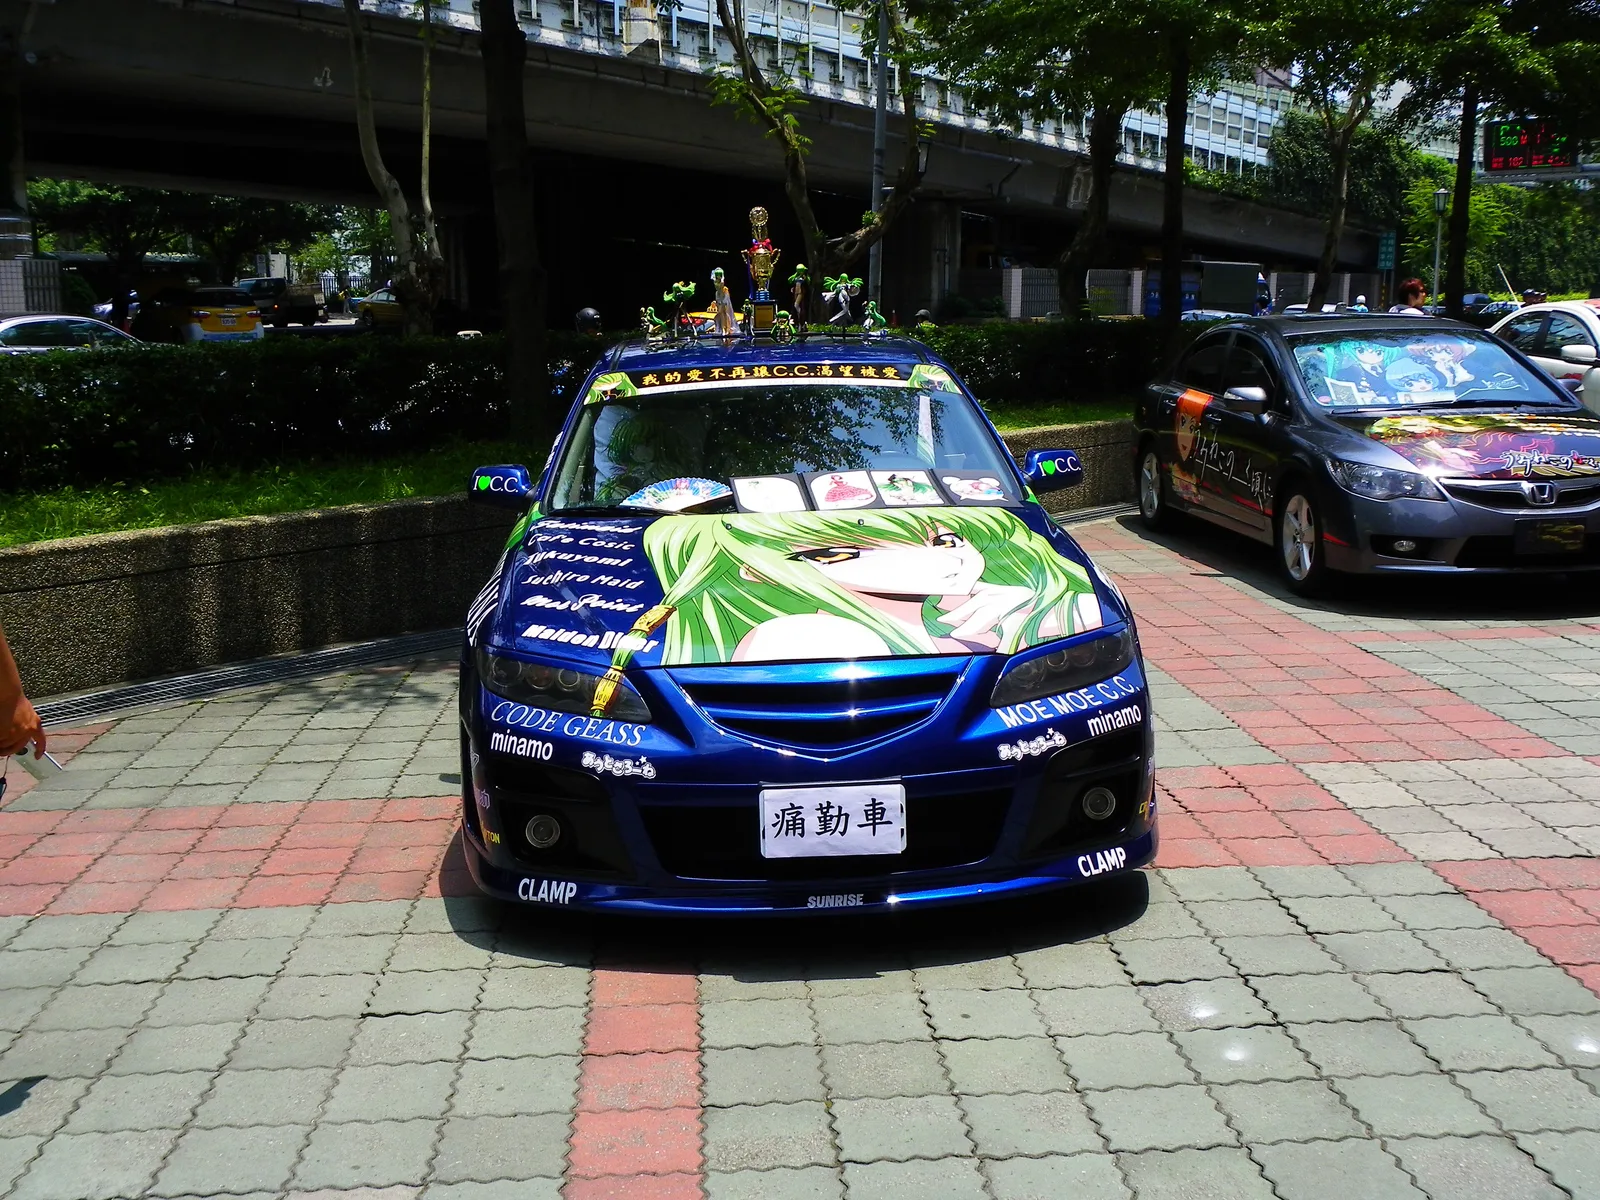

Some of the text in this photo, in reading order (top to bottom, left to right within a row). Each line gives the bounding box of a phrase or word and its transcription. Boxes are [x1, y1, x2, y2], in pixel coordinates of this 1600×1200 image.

[641, 364, 901, 386] 我的愛不再讓C.C.渴望被愛
[1037, 456, 1081, 477] I C.C.
[472, 476, 519, 493] I C.C.
[578, 537, 636, 551] Cosic
[590, 574, 645, 590] Maid
[997, 677, 1141, 729] MOE MOE C.C.
[492, 701, 647, 748] CODE GEASS
[1087, 705, 1142, 737] minamo
[490, 729, 554, 762] minamo
[773, 798, 889, 839] 痛勤車
[1078, 847, 1127, 878] CLAMP
[518, 877, 578, 905] CLAMP
[807, 894, 864, 909] SUNRISE
